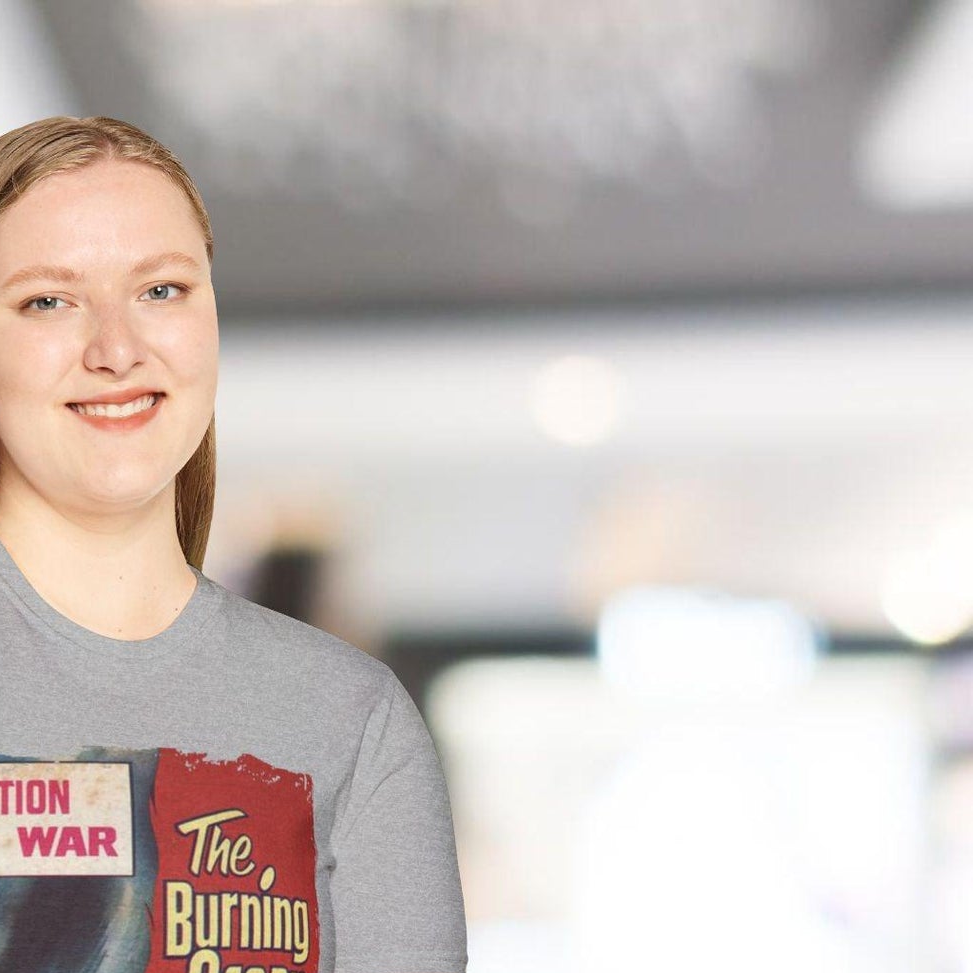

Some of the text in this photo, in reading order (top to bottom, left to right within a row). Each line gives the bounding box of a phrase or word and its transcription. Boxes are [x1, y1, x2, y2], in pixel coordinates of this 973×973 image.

[17, 826, 119, 858] WAR
[175, 808, 256, 876] The
[163, 866, 310, 964] Burning
